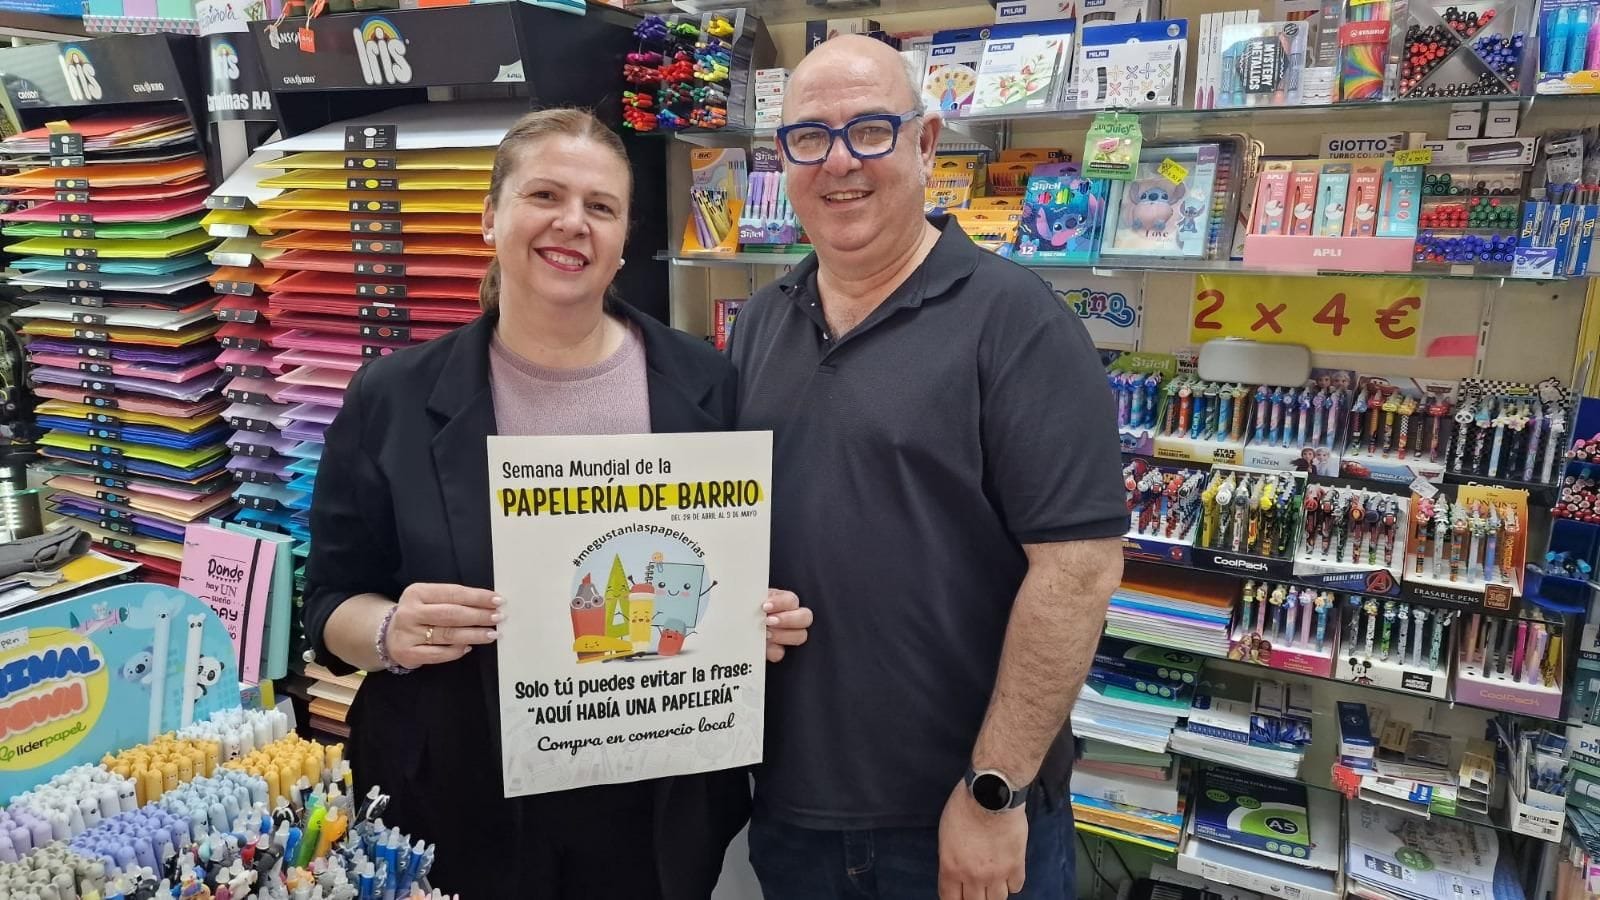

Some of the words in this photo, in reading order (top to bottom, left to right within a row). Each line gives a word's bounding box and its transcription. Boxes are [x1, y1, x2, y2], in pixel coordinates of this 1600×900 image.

[1003, 7, 1024, 15] MILAN
[353, 27, 413, 85] Iris
[1249, 41, 1262, 90] METALLICS
[1262, 43, 1276, 87] MYSTERY
[58, 50, 103, 101] Iris
[252, 91, 272, 110] A4
[1328, 139, 1387, 151] GIOTTO
[1021, 246, 1033, 255] 12
[1313, 249, 1343, 257] APLI
[1194, 289, 1225, 330] 2
[1312, 293, 1349, 336] 4
[1375, 296, 1421, 339] €
[502, 461, 564, 479] Semana
[569, 459, 630, 477] Mundial
[635, 459, 653, 475] de
[658, 458, 672, 474] la
[502, 478, 628, 517] PAPELERÍA
[638, 483, 668, 512] DE
[678, 479, 760, 510] BARRIO
[692, 513, 700, 521] DE
[701, 512, 717, 520] ABRIL
[740, 510, 757, 518] MAYO
[207, 558, 244, 583] Donde
[1213, 556, 1269, 573] CoolPack
[206, 582, 219, 592] hay
[220, 583, 238, 597] UN
[211, 595, 231, 605] sueño
[1414, 588, 1453, 600] ERASABLE
[1457, 594, 1479, 603] PENS
[515, 681, 549, 699] Solo
[554, 678, 574, 697] tú
[578, 674, 635, 698] puedes
[641, 669, 687, 688] evitar
[692, 666, 706, 682] la
[710, 662, 753, 680] frase:
[528, 701, 572, 725] “AQUÍ
[576, 696, 621, 721] HABÍA
[626, 697, 657, 718] UNA
[661, 685, 740, 712] PAPELERÍA”
[16, 721, 87, 757] liderpapel
[537, 735, 603, 756] Compra
[606, 733, 625, 745] en
[628, 723, 696, 743] comercio
[698, 712, 735, 733] local
[1269, 819, 1296, 832] A5
